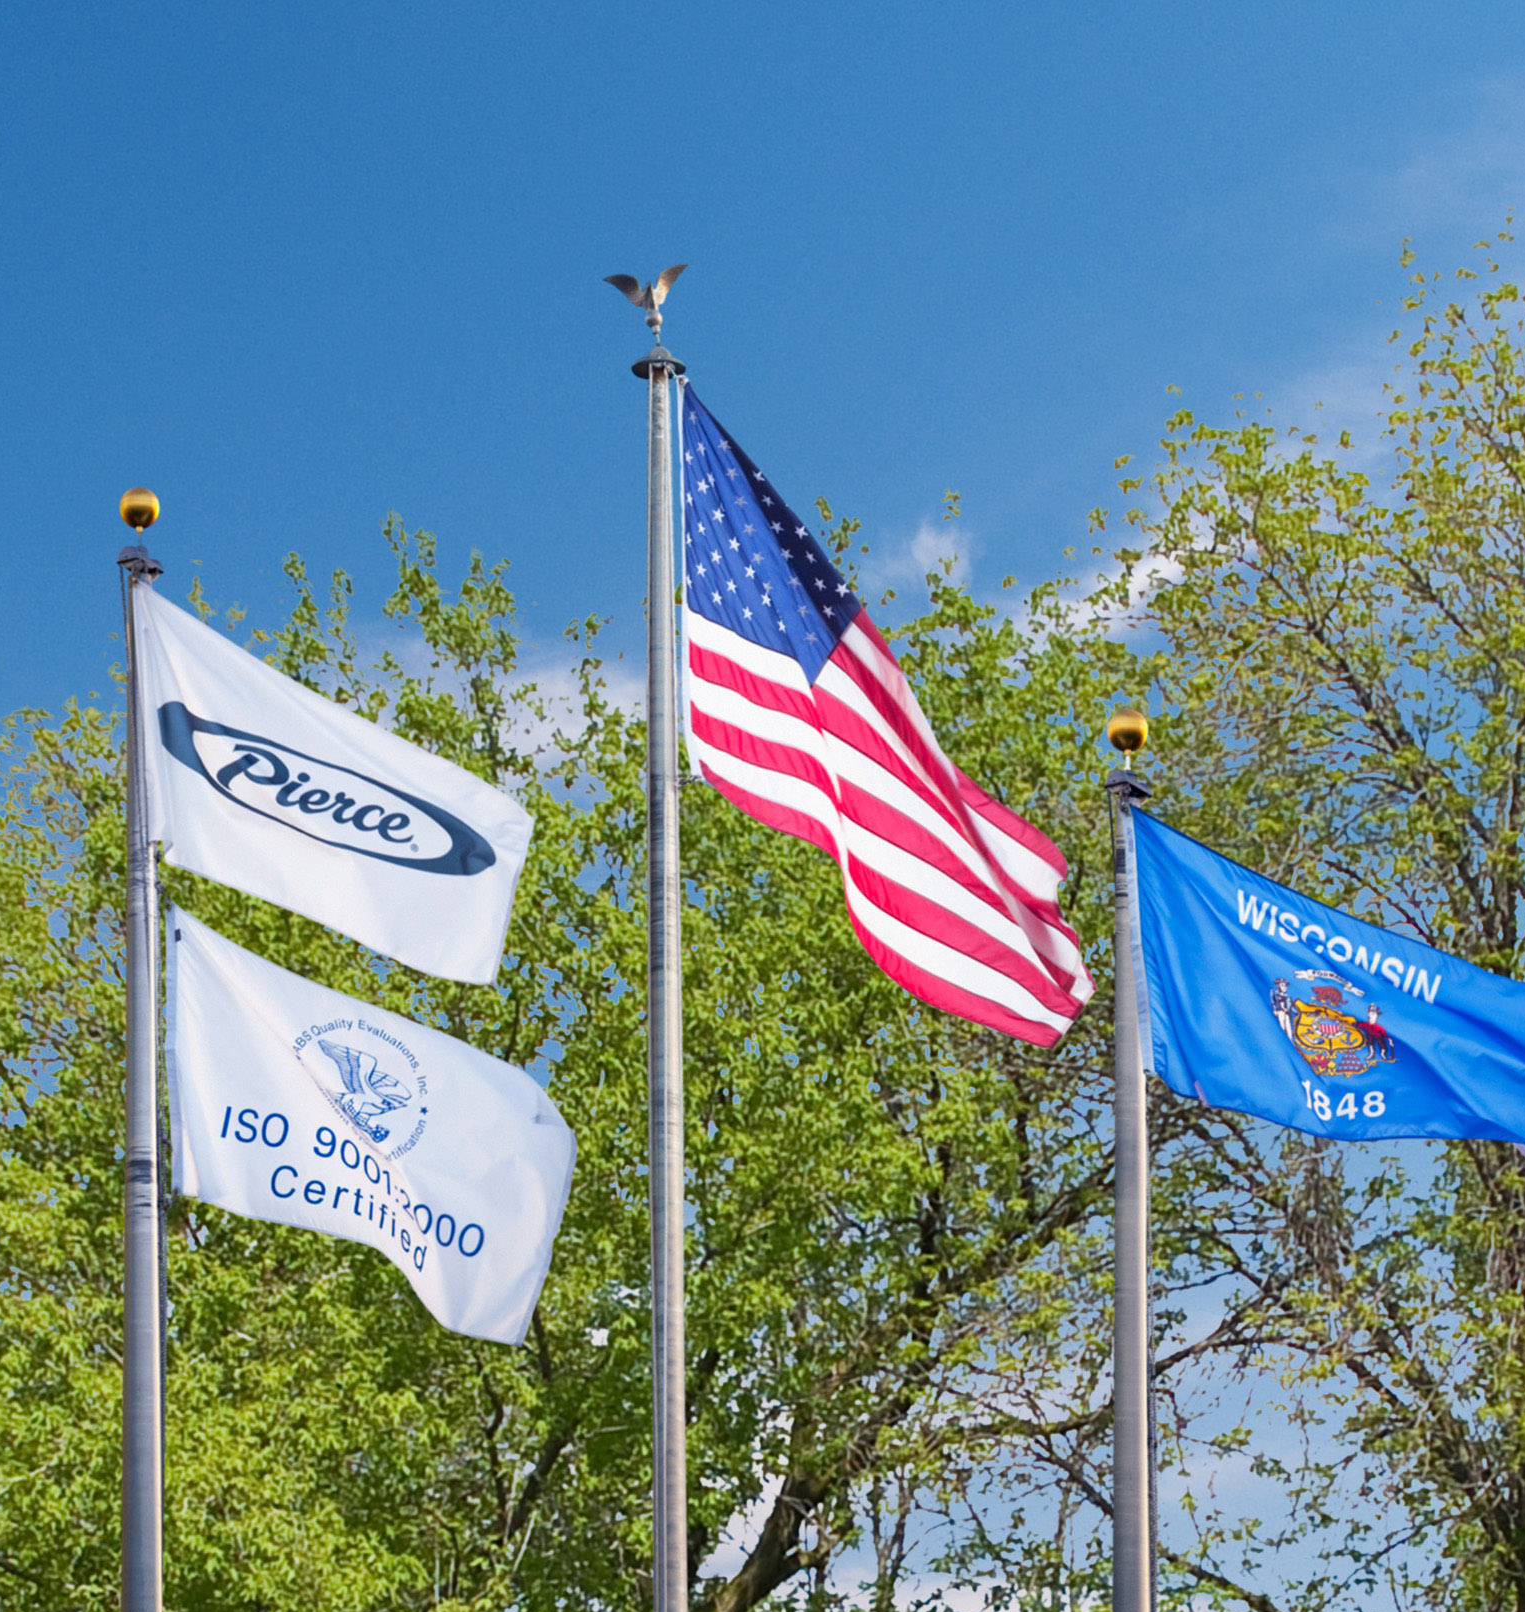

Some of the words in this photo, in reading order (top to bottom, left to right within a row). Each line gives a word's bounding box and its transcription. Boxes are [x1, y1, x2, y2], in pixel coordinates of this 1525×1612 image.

[216, 744, 414, 843] Pierce
[1237, 889, 1442, 1004] WISCONSIN
[292, 1031, 312, 1054] ABS
[311, 1018, 353, 1036] Quality
[358, 1019, 420, 1073] Evaluations,
[417, 1075, 428, 1098] Inc.
[1301, 1079, 1386, 1122] 1848
[221, 1106, 289, 1148] ISO
[313, 1126, 485, 1257] 9001:2000
[271, 1165, 427, 1273] Certified
